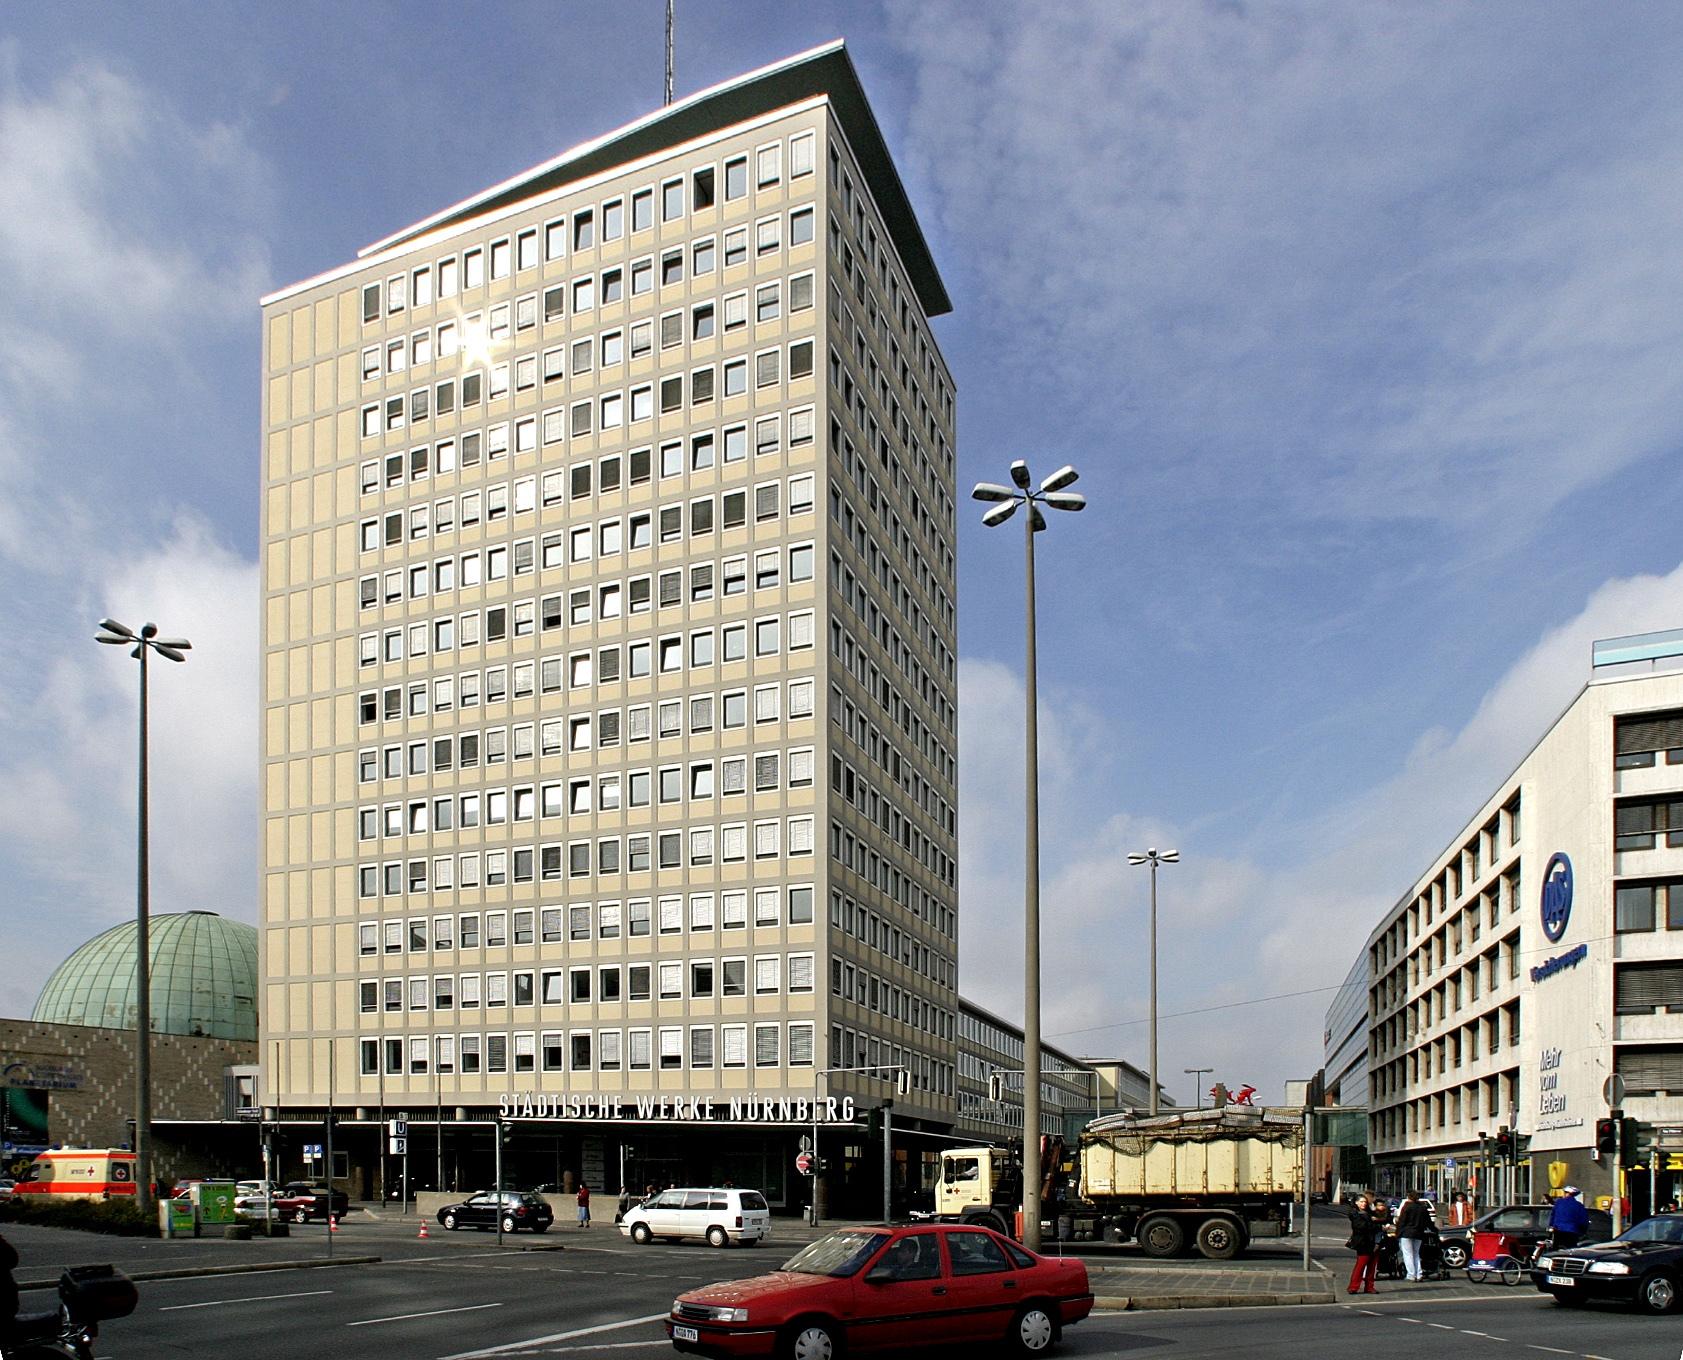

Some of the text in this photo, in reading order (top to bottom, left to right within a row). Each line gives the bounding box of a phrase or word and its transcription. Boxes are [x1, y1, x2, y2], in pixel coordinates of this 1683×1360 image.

[500, 1090, 855, 1122] STÄDTISCHE WERKE NÜRNBERG
[1540, 1093, 1566, 1116] Leben
[397, 1121, 405, 1134] U
